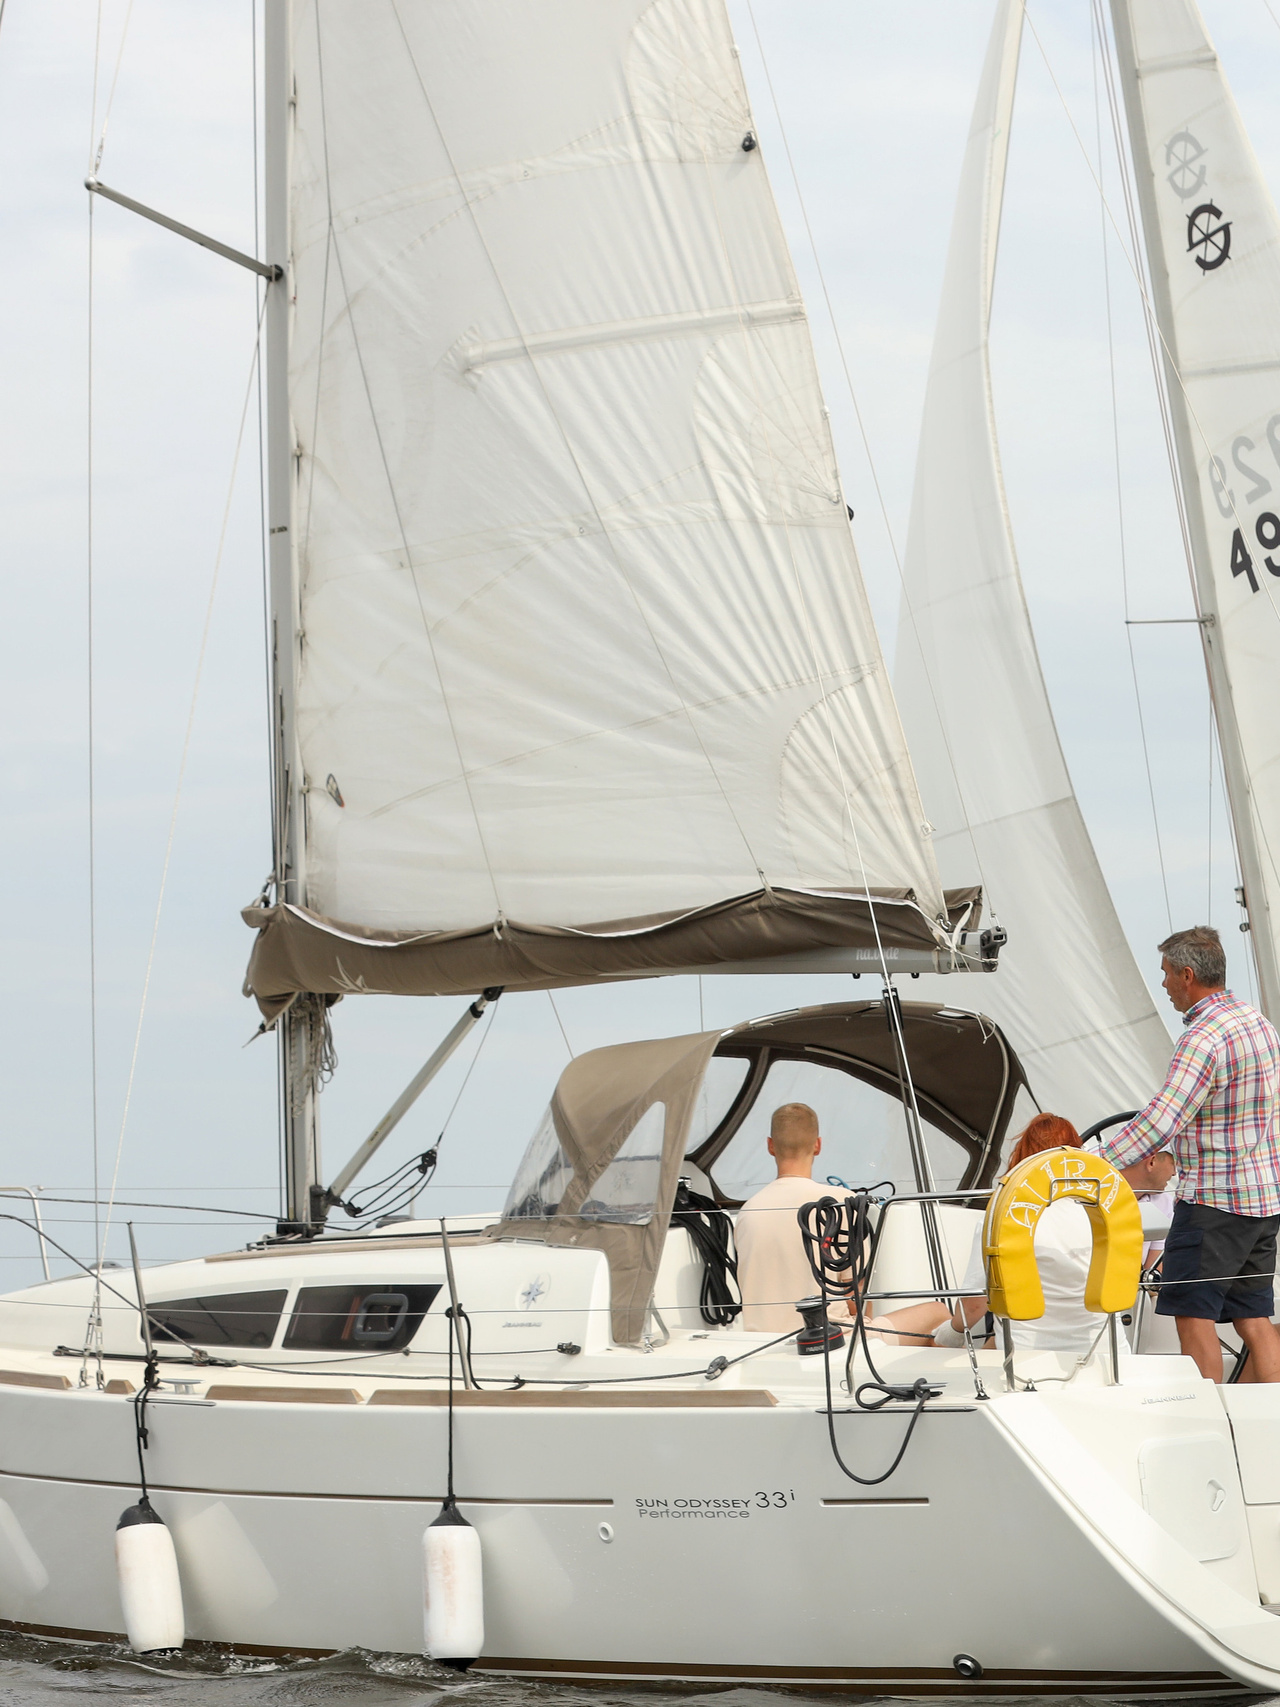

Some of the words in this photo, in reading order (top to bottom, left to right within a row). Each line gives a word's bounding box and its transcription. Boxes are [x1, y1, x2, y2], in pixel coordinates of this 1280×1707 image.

[856, 947, 899, 960] na.vde
[1005, 1157, 1123, 1236] AURA
[635, 1499, 668, 1508] SUN
[673, 1499, 751, 1508] ODYSSEY
[638, 1509, 750, 1518] Performance
